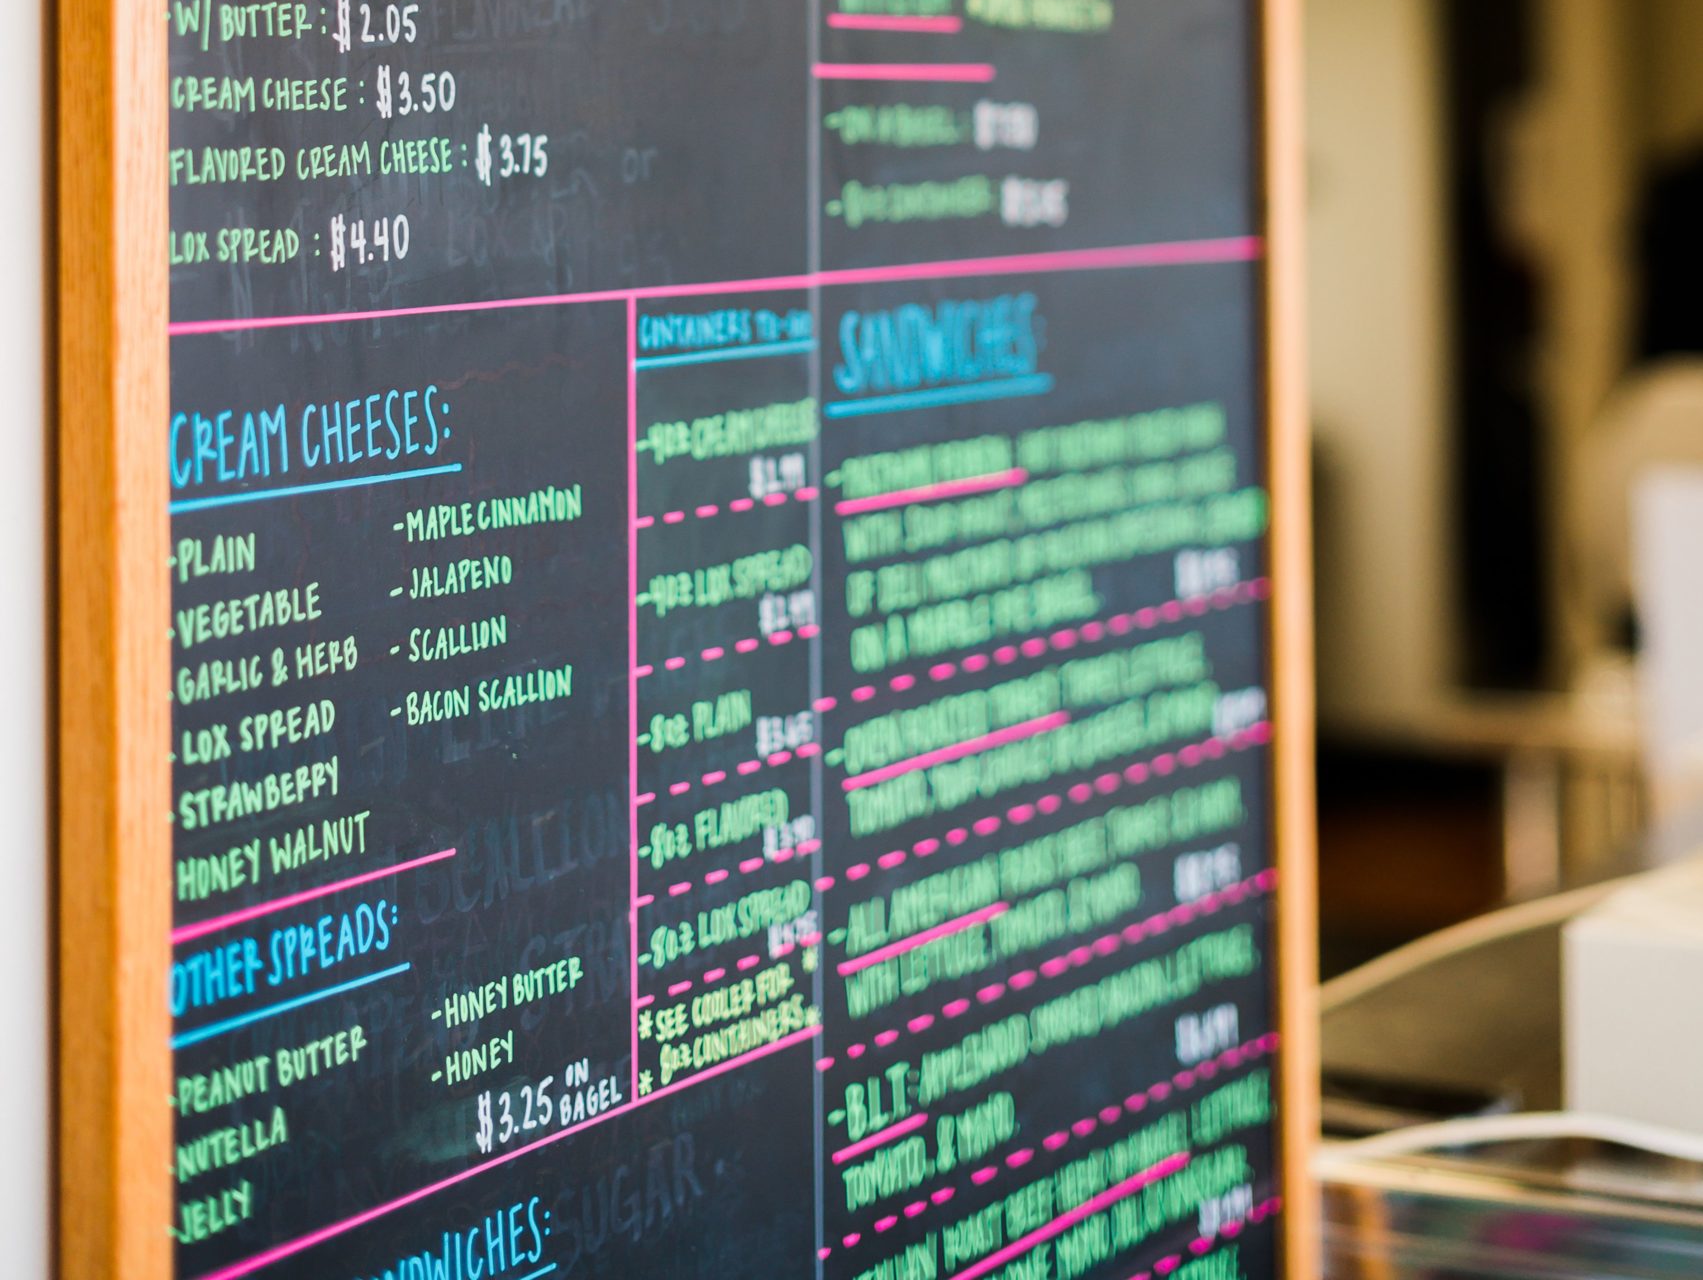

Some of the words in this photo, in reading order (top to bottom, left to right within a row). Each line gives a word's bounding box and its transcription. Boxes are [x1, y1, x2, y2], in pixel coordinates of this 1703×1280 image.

[171, 76, 255, 113] CREAM
[376, 64, 456, 118] $3.50
[169, 146, 286, 187] FLAVORED
[297, 141, 371, 179] CREAM
[169, 229, 210, 265] LOX
[330, 213, 410, 272] $4.40
[169, 403, 289, 489] CREAM
[302, 384, 451, 467] CHEESES:
[406, 502, 475, 543] MAPLE
[477, 484, 582, 531] CINNAMON
[178, 532, 256, 583] PLAIN
[409, 555, 512, 600] JALAPENO
[177, 582, 322, 649] VEGETABLE
[408, 614, 507, 663] SCALLION
[177, 655, 263, 706] GARLIC
[271, 648, 288, 687] &
[296, 636, 358, 682] HERB
[406, 686, 470, 727] BACON
[478, 664, 573, 712] SCALLION
[182, 723, 231, 765] LOX
[239, 698, 336, 752] SPREAD
[180, 756, 340, 830] STRAWBERRY
[177, 838, 261, 902] HONEY
[269, 811, 370, 874] WALNUT
[169, 937, 264, 1017] OTHER
[268, 899, 399, 986] SPREADS:
[445, 976, 508, 1029] HONEY
[512, 956, 584, 1008] BUTTER
[178, 1055, 270, 1117] PEANUT
[277, 1024, 367, 1087] BUTTER
[445, 1030, 514, 1086] HONEY
[565, 1058, 589, 1089] ON
[476, 1076, 553, 1154] $3.25
[560, 1075, 622, 1126] BAGEL
[177, 1105, 288, 1183] NUTELLA
[177, 1180, 252, 1245] JELLY
